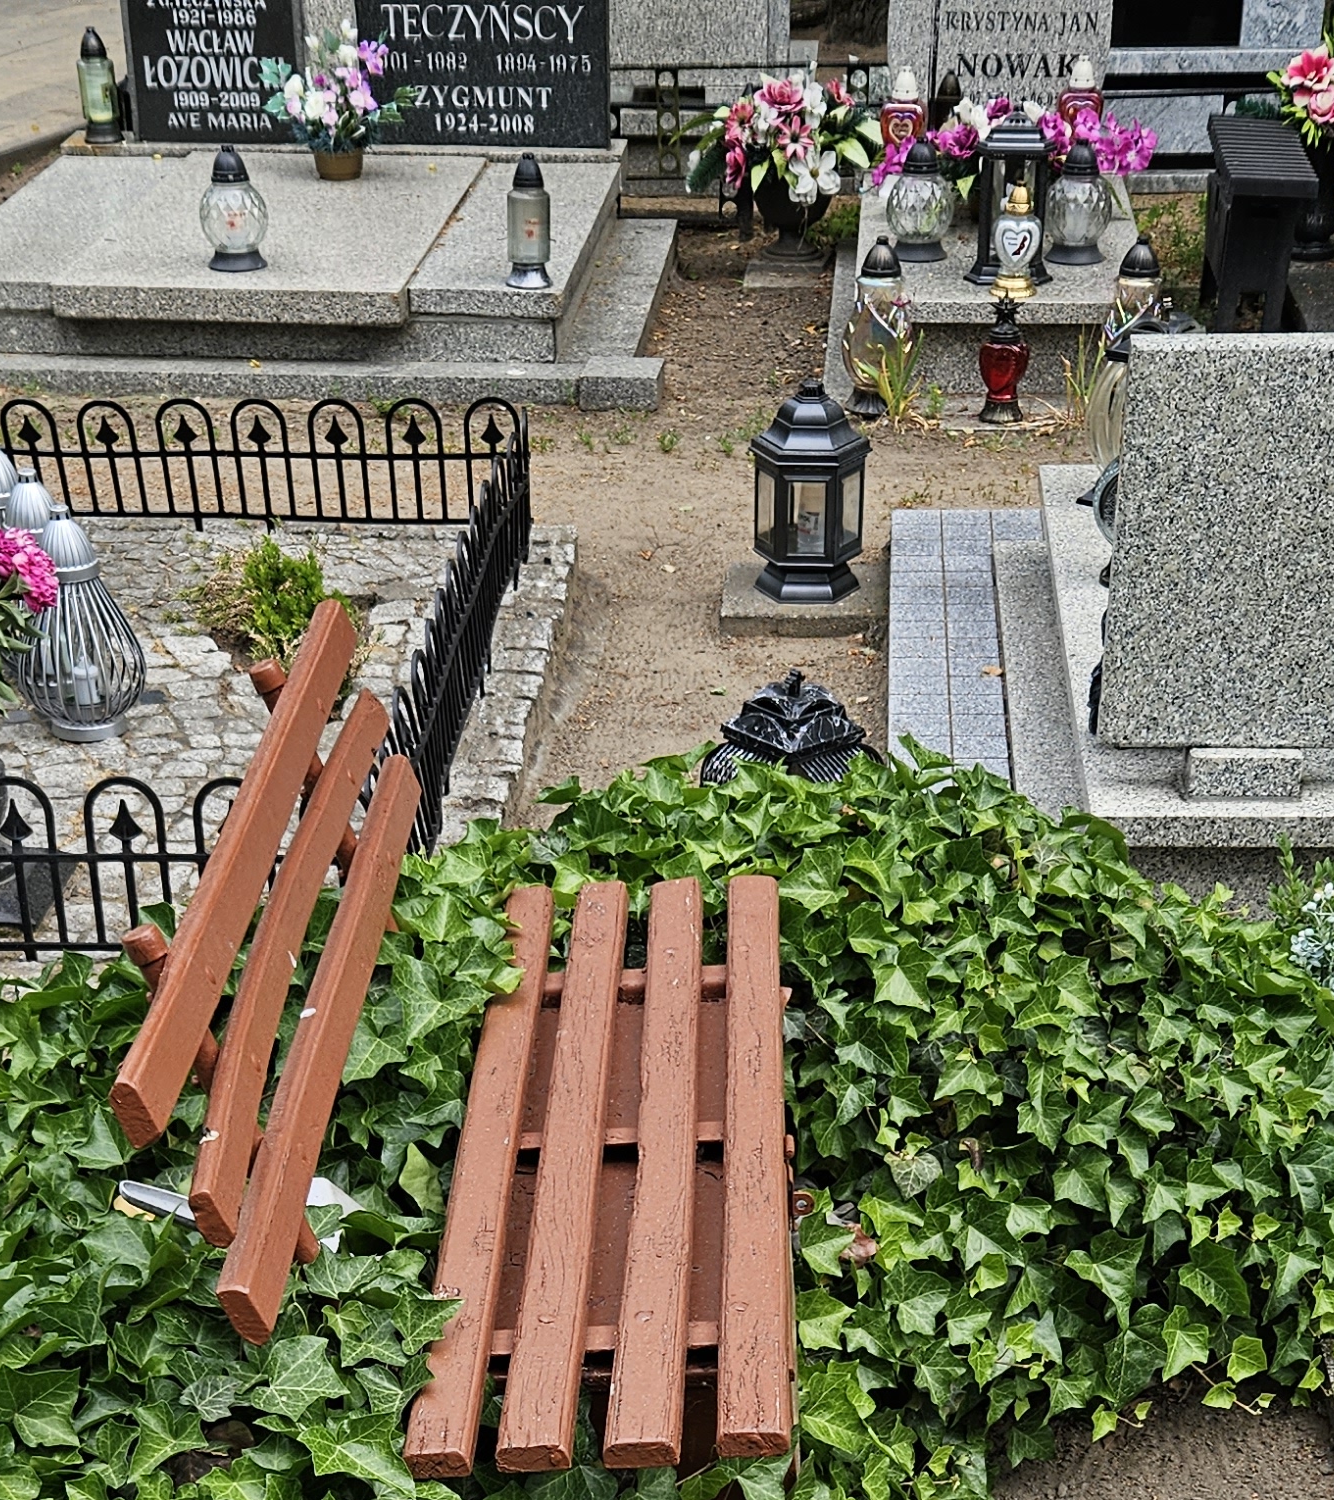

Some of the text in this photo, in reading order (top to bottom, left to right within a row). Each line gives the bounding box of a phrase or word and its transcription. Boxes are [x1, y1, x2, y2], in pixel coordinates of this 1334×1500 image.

[172, 8, 257, 27] 1921-1986
[380, 1, 584, 44] TĘCZYŃSCY
[945, 11, 1099, 36] KRYSTYNA JAN
[166, 29, 255, 55] WACŁAW
[957, 53, 1080, 78] NOWAK
[173, 91, 261, 109] 1909-2009
[415, 85, 553, 110] ZYGMUNT
[168, 112, 273, 131] AVE MARIA
[434, 113, 535, 134] 1924-2008
